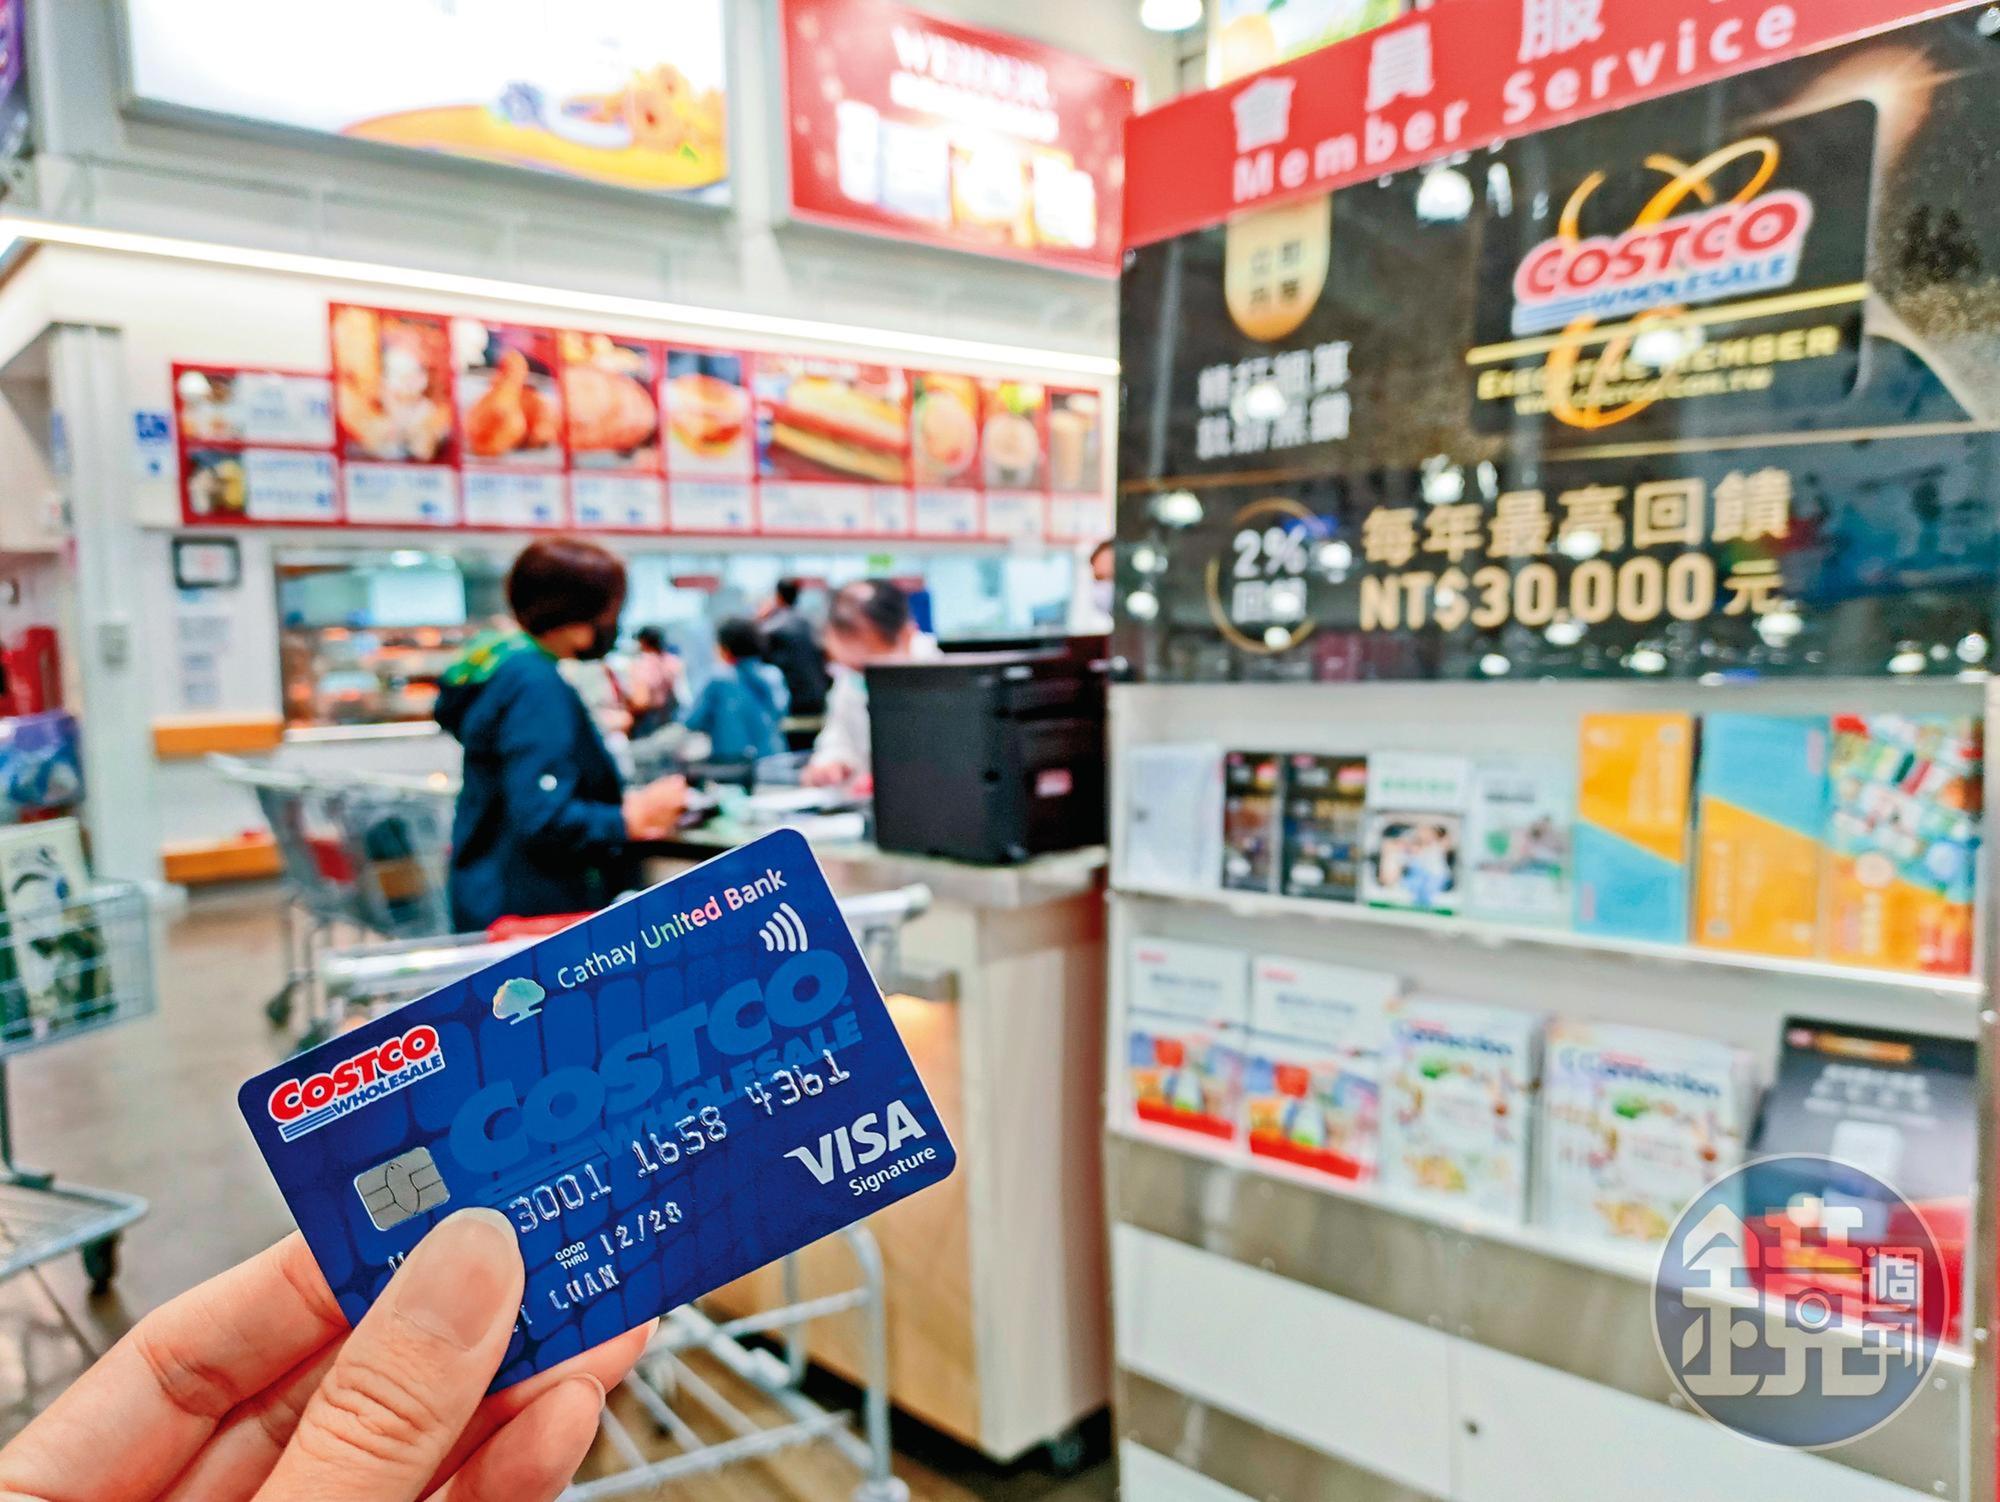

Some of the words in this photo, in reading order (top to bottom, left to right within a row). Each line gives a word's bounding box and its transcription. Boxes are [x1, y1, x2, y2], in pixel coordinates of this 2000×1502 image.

[1233, 99, 1469, 203] Member
[1503, 4, 1796, 125] Service
[1517, 200, 1799, 297] COSTCO
[1233, 525, 1307, 578] 2%
[1361, 467, 1791, 567] 每年最高回饋
[557, 940, 637, 988] Cathay
[641, 896, 722, 949] United
[724, 868, 788, 911] Bank
[269, 1026, 439, 1122] COSTCO
[332, 1054, 443, 1115] WHOLESALE
[449, 949, 848, 1174] COSTCO
[508, 1163, 613, 1233] 3001
[631, 1105, 728, 1178] 1658
[744, 1048, 850, 1116] 4361
[783, 1099, 927, 1185] VISA
[849, 1147, 937, 1196] Signature
[555, 1241, 586, 1262] GOOD
[560, 1251, 590, 1270] THRU
